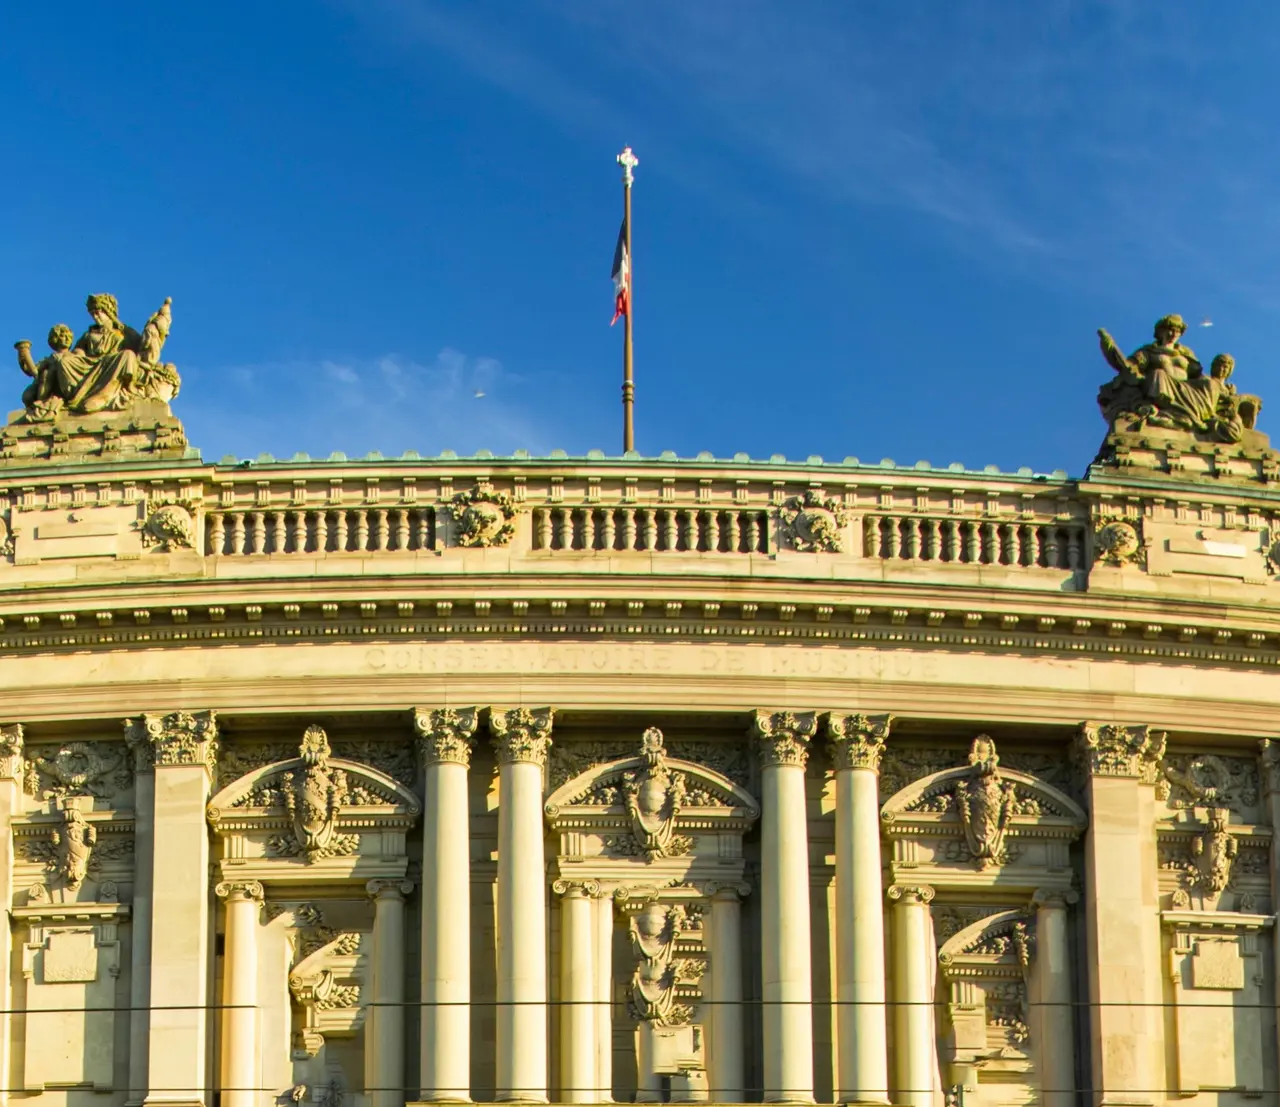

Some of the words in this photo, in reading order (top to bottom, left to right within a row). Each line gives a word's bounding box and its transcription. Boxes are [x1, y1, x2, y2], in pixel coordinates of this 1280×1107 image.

[365, 647, 673, 671] CONSERVATOIRE
[699, 649, 746, 672] DE
[772, 651, 939, 678] MUSIQUE
